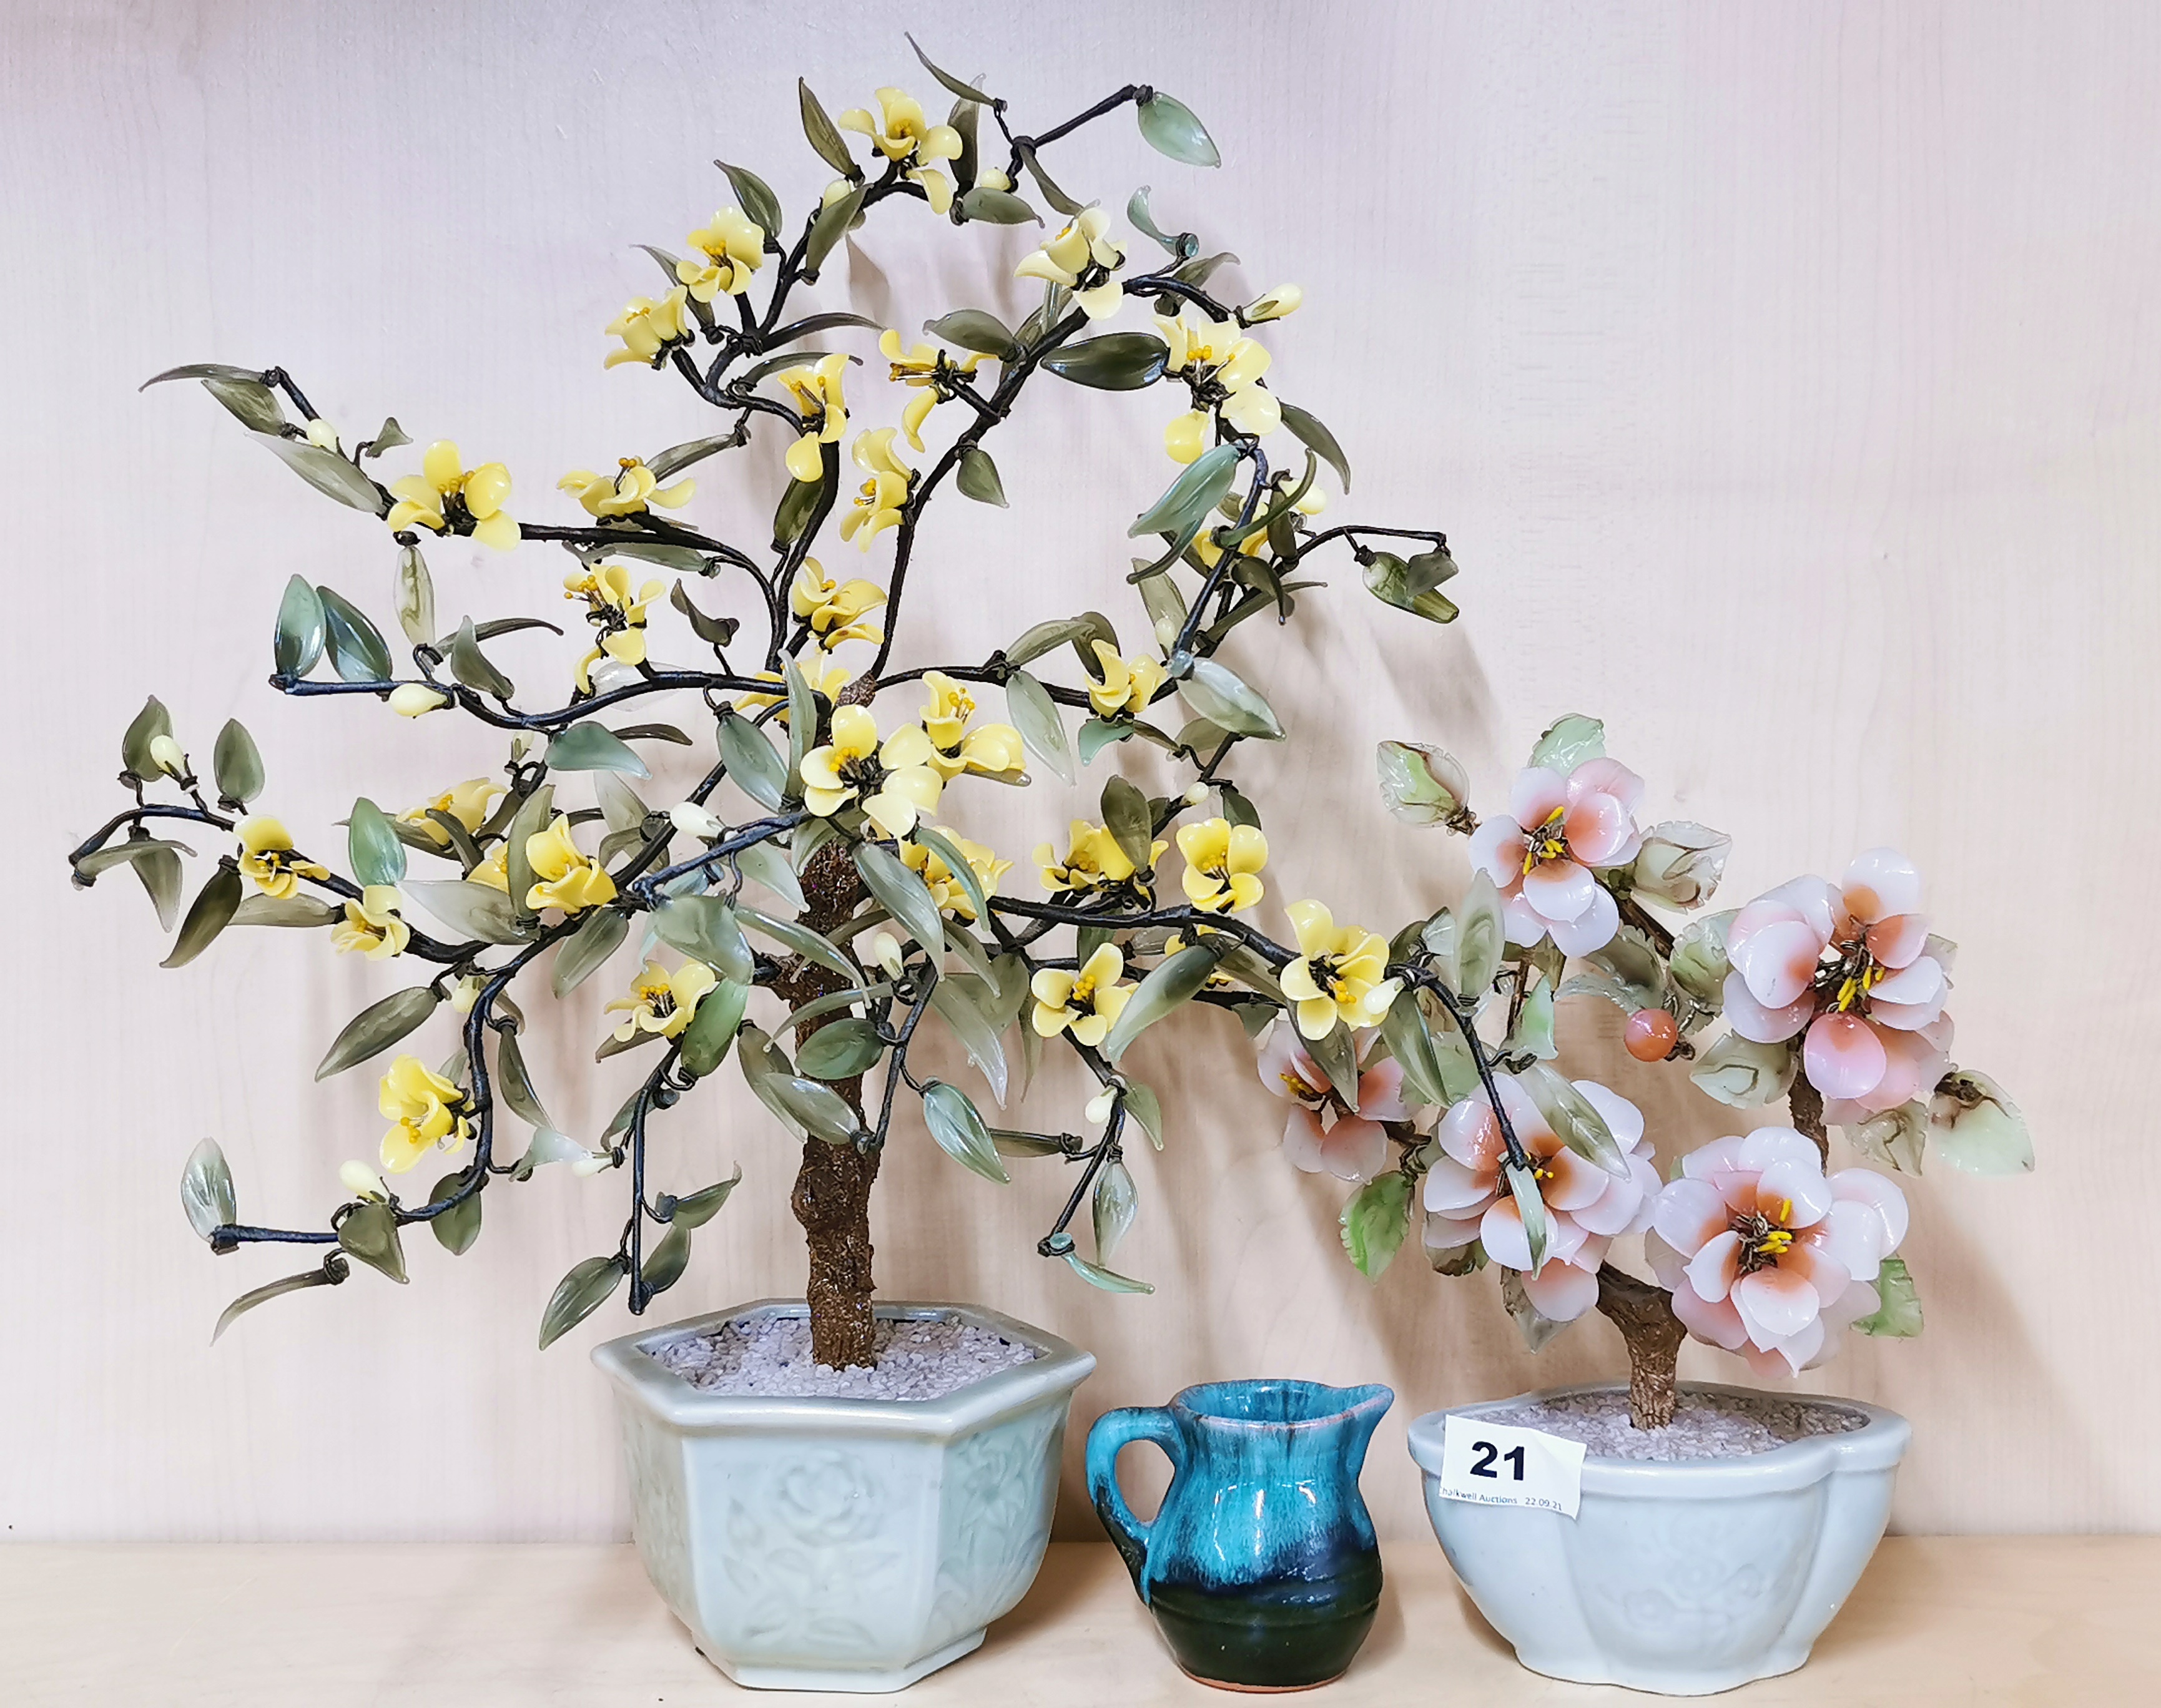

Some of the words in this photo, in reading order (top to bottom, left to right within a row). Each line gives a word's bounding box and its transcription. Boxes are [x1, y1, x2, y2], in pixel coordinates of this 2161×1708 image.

[1470, 1441, 1525, 1481] 21
[1439, 1487, 1477, 1501] halkwell
[1479, 1494, 1517, 1504] Auctions
